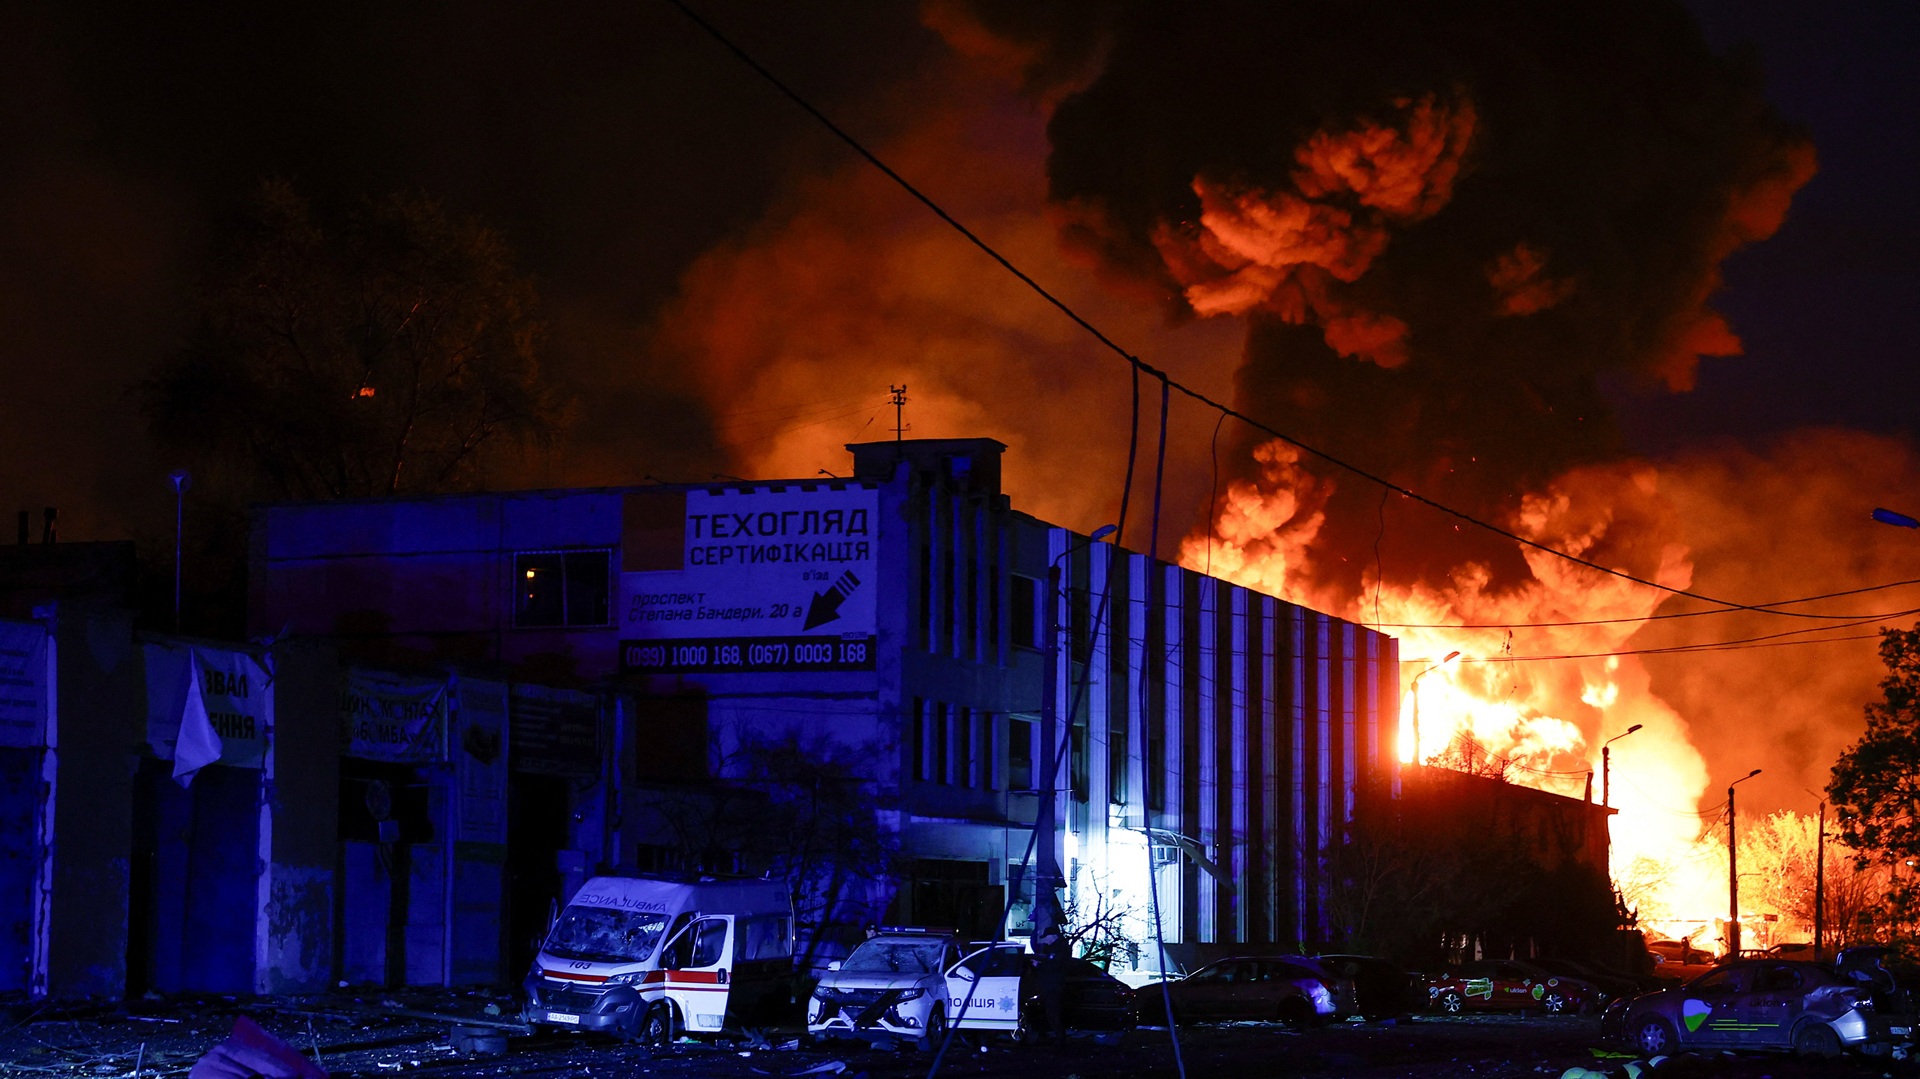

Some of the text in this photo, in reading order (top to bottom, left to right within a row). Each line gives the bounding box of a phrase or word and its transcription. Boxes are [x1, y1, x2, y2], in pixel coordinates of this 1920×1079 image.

[689, 508, 868, 539] ТЕХОГЛЯД
[690, 541, 870, 565] СЕРТИФІКАЦІЯ
[632, 593, 706, 608] проспект
[628, 607, 693, 622] Степана
[769, 603, 789, 618] 20
[625, 643, 867, 667] (099) 1000 168, (067) 0003 168
[569, 961, 592, 970] 103
[948, 997, 995, 1009] ПОІЦІЯ
